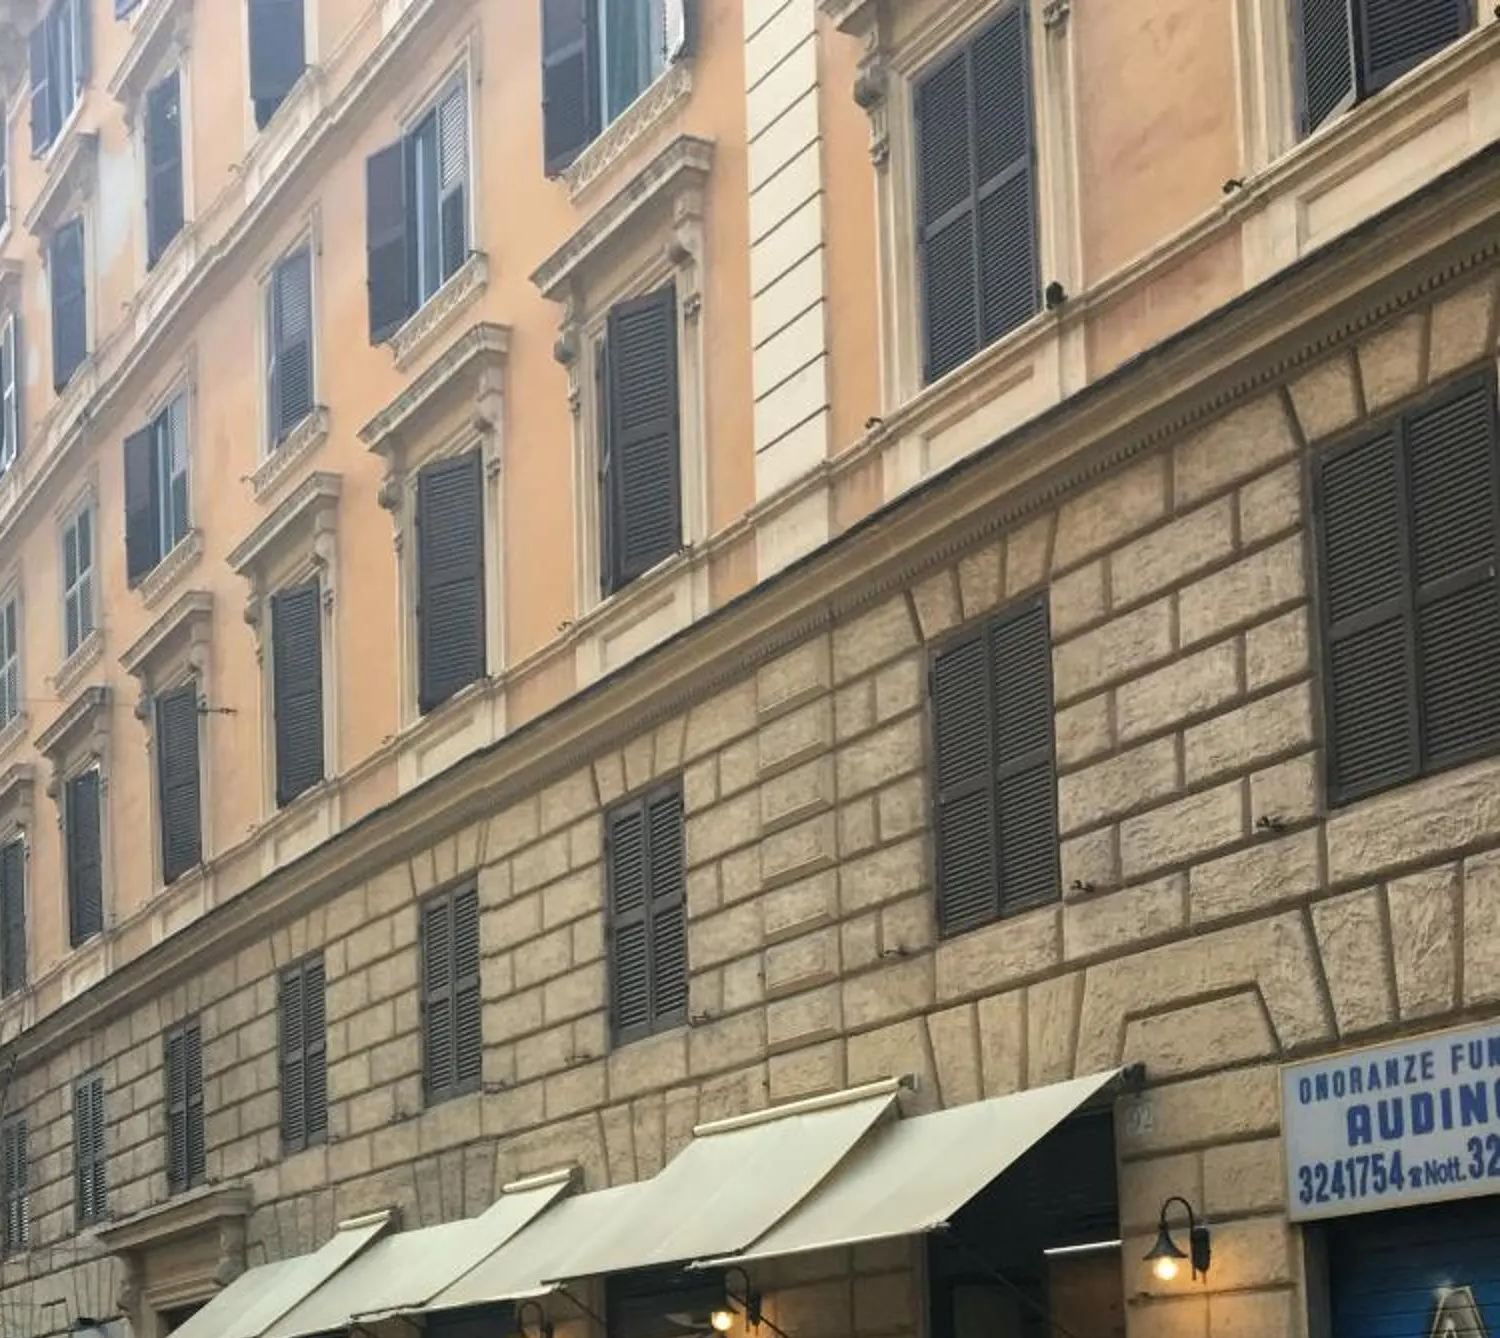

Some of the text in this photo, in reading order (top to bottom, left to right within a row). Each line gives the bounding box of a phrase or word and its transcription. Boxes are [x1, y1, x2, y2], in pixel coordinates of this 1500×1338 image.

[1300, 1052, 1435, 1104] ONORANZE
[1347, 1079, 1500, 1147] AUDIN
[1299, 1150, 1405, 1205] 3241754
